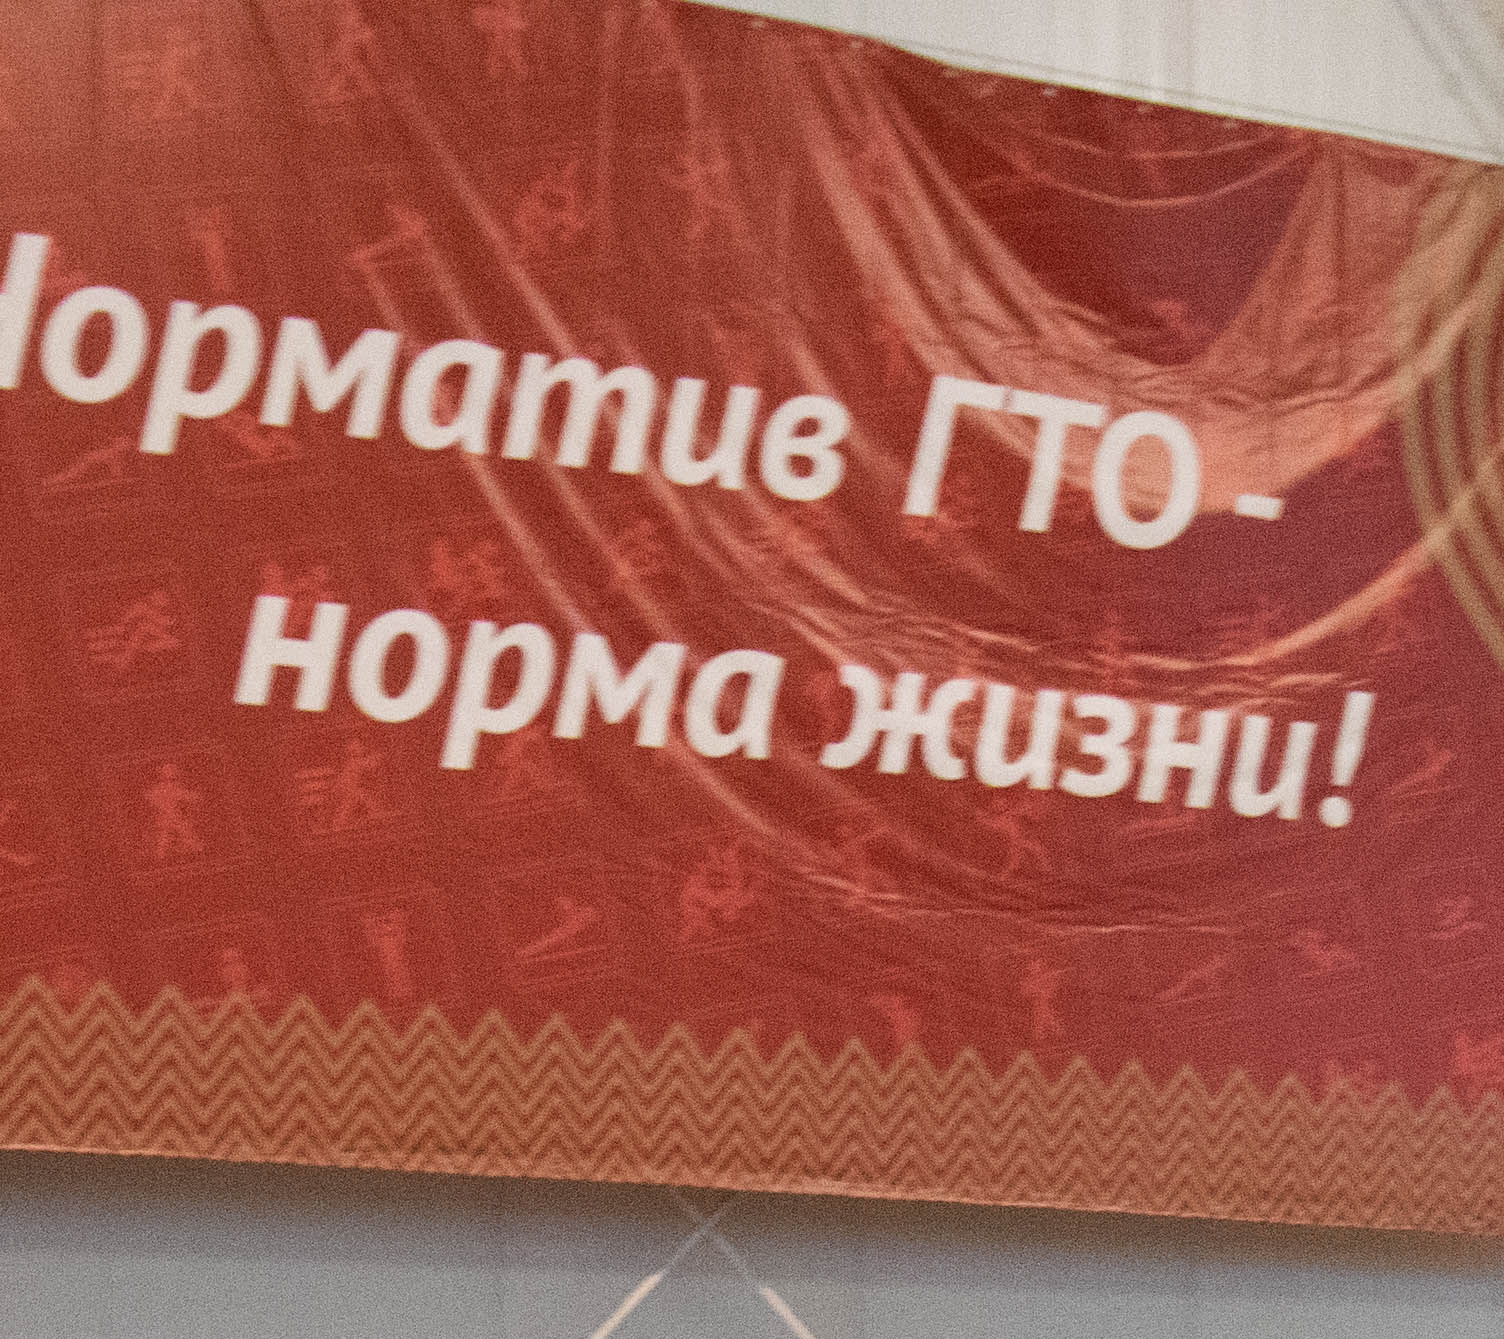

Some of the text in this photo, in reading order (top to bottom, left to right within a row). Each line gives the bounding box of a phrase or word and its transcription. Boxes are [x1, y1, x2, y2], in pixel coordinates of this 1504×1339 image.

[902, 371, 1204, 551] ГТО
[233, 593, 1375, 830] норма жизни!
